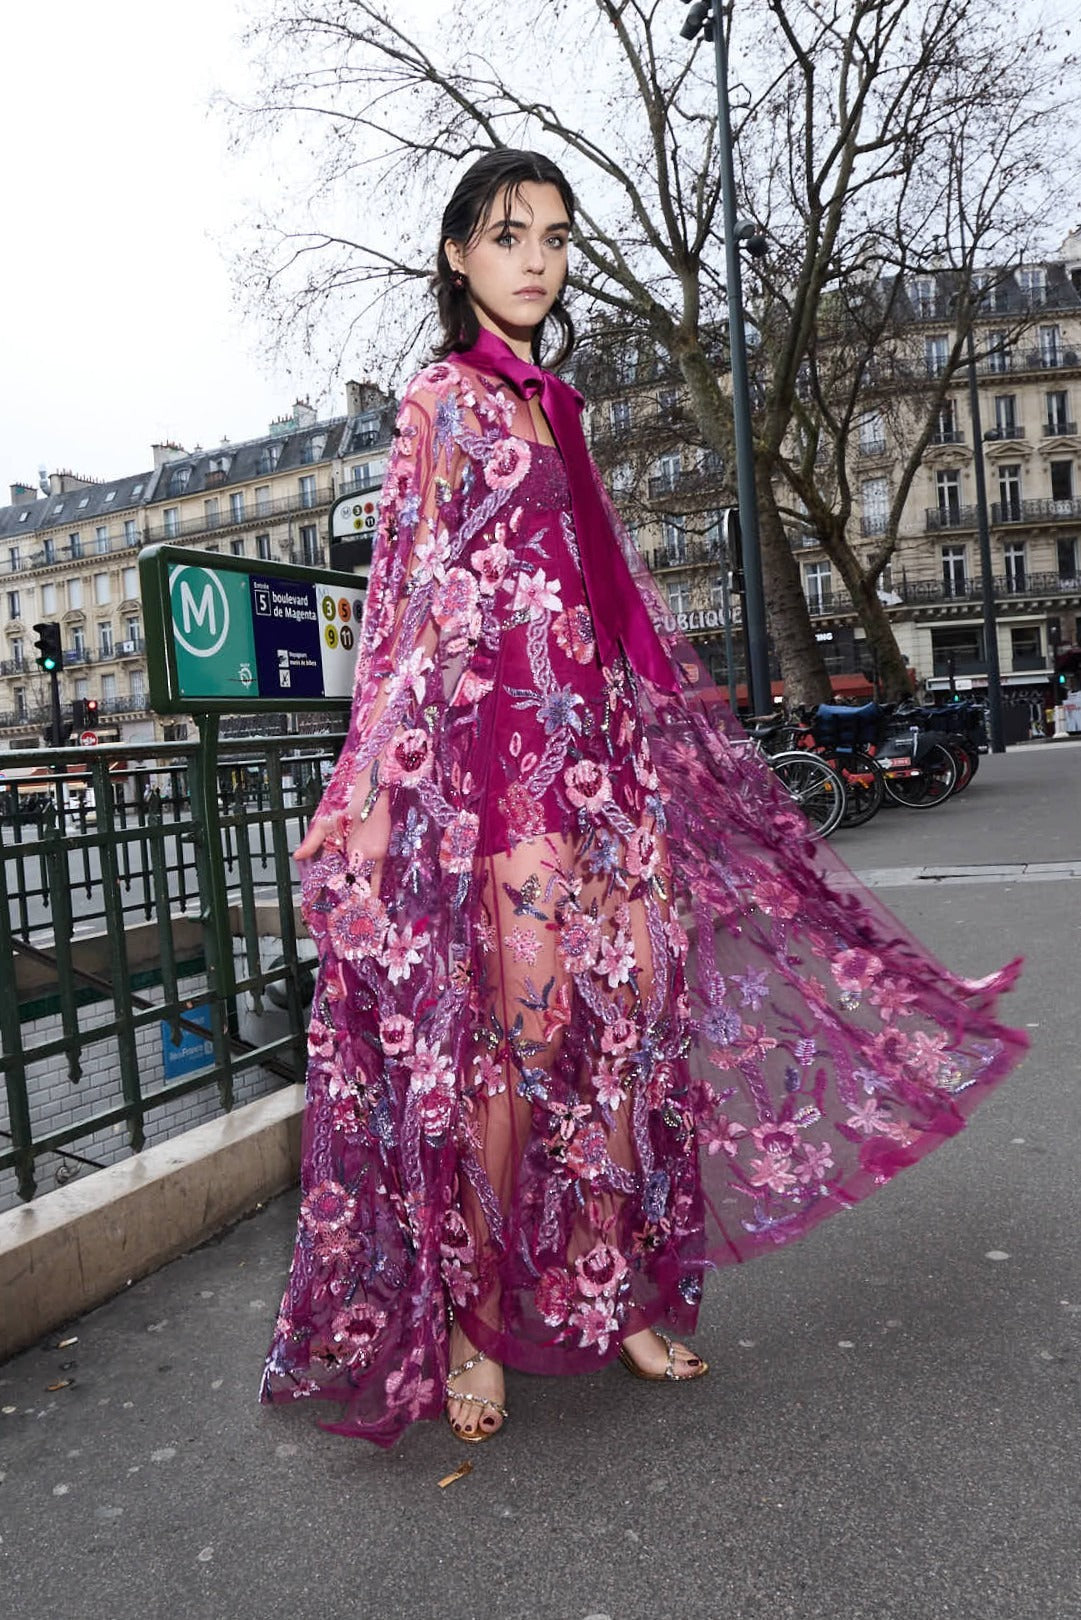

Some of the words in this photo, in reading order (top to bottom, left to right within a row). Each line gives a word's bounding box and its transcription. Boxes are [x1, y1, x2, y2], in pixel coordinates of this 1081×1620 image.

[180, 581, 216, 635] M
[260, 594, 267, 611] 5
[272, 591, 308, 606] boulevard
[273, 606, 283, 617] de
[285, 607, 317, 622] Magenta
[341, 631, 352, 646] 11
